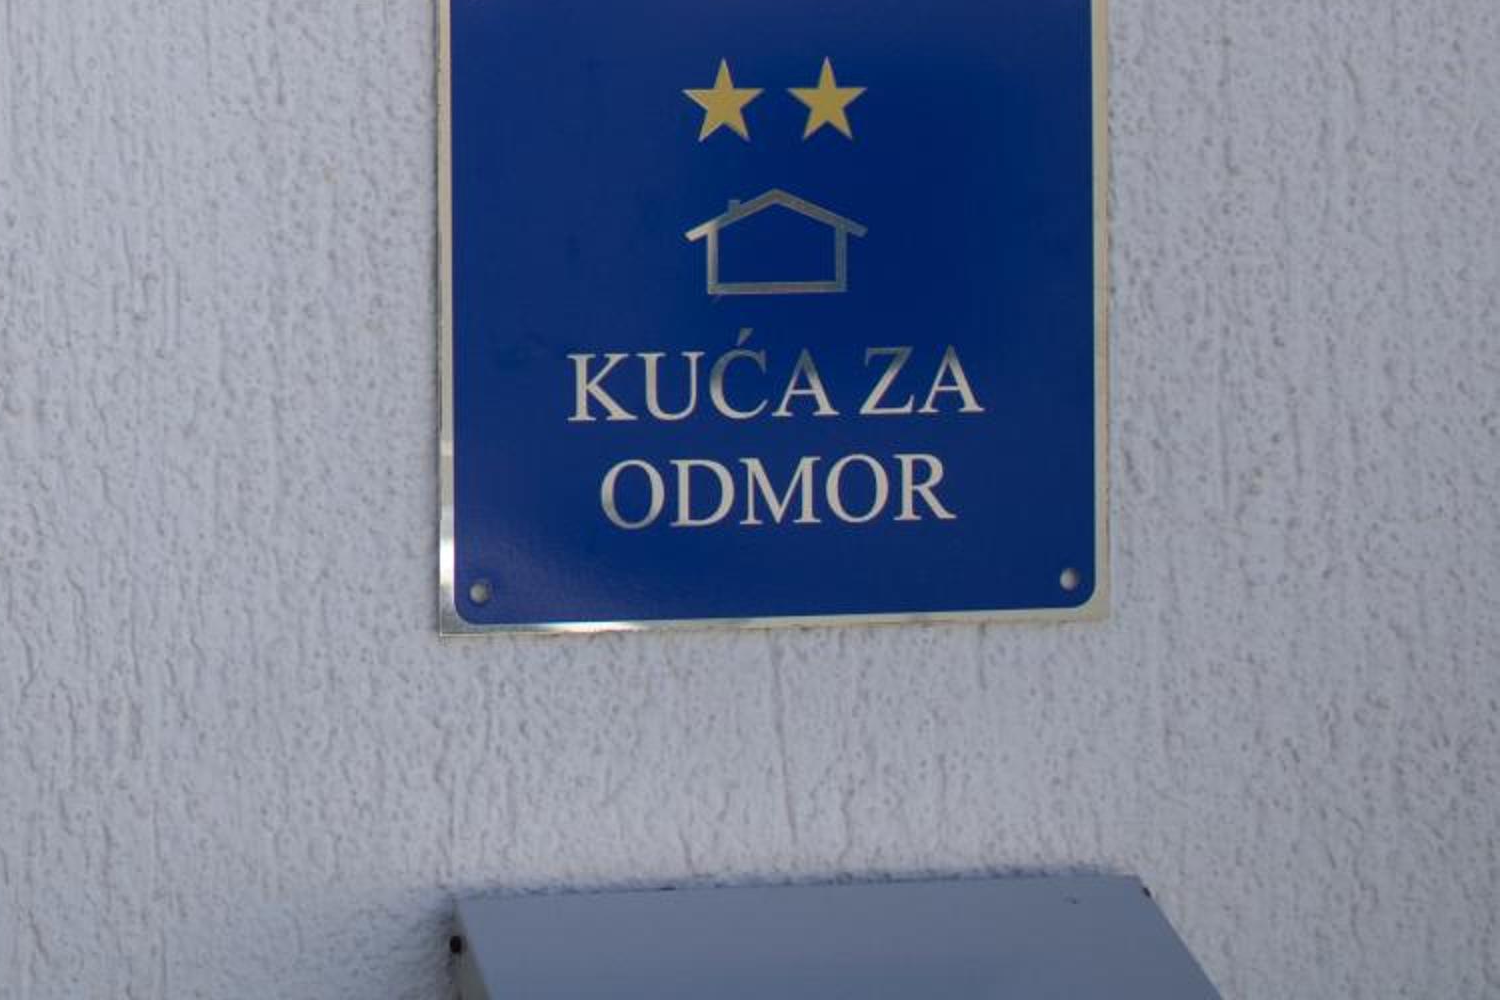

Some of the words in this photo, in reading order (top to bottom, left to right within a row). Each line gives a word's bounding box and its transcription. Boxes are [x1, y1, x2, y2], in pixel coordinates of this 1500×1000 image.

[567, 328, 839, 422] KUĆA
[860, 345, 985, 416] ZA
[600, 453, 957, 529] ODMOR
